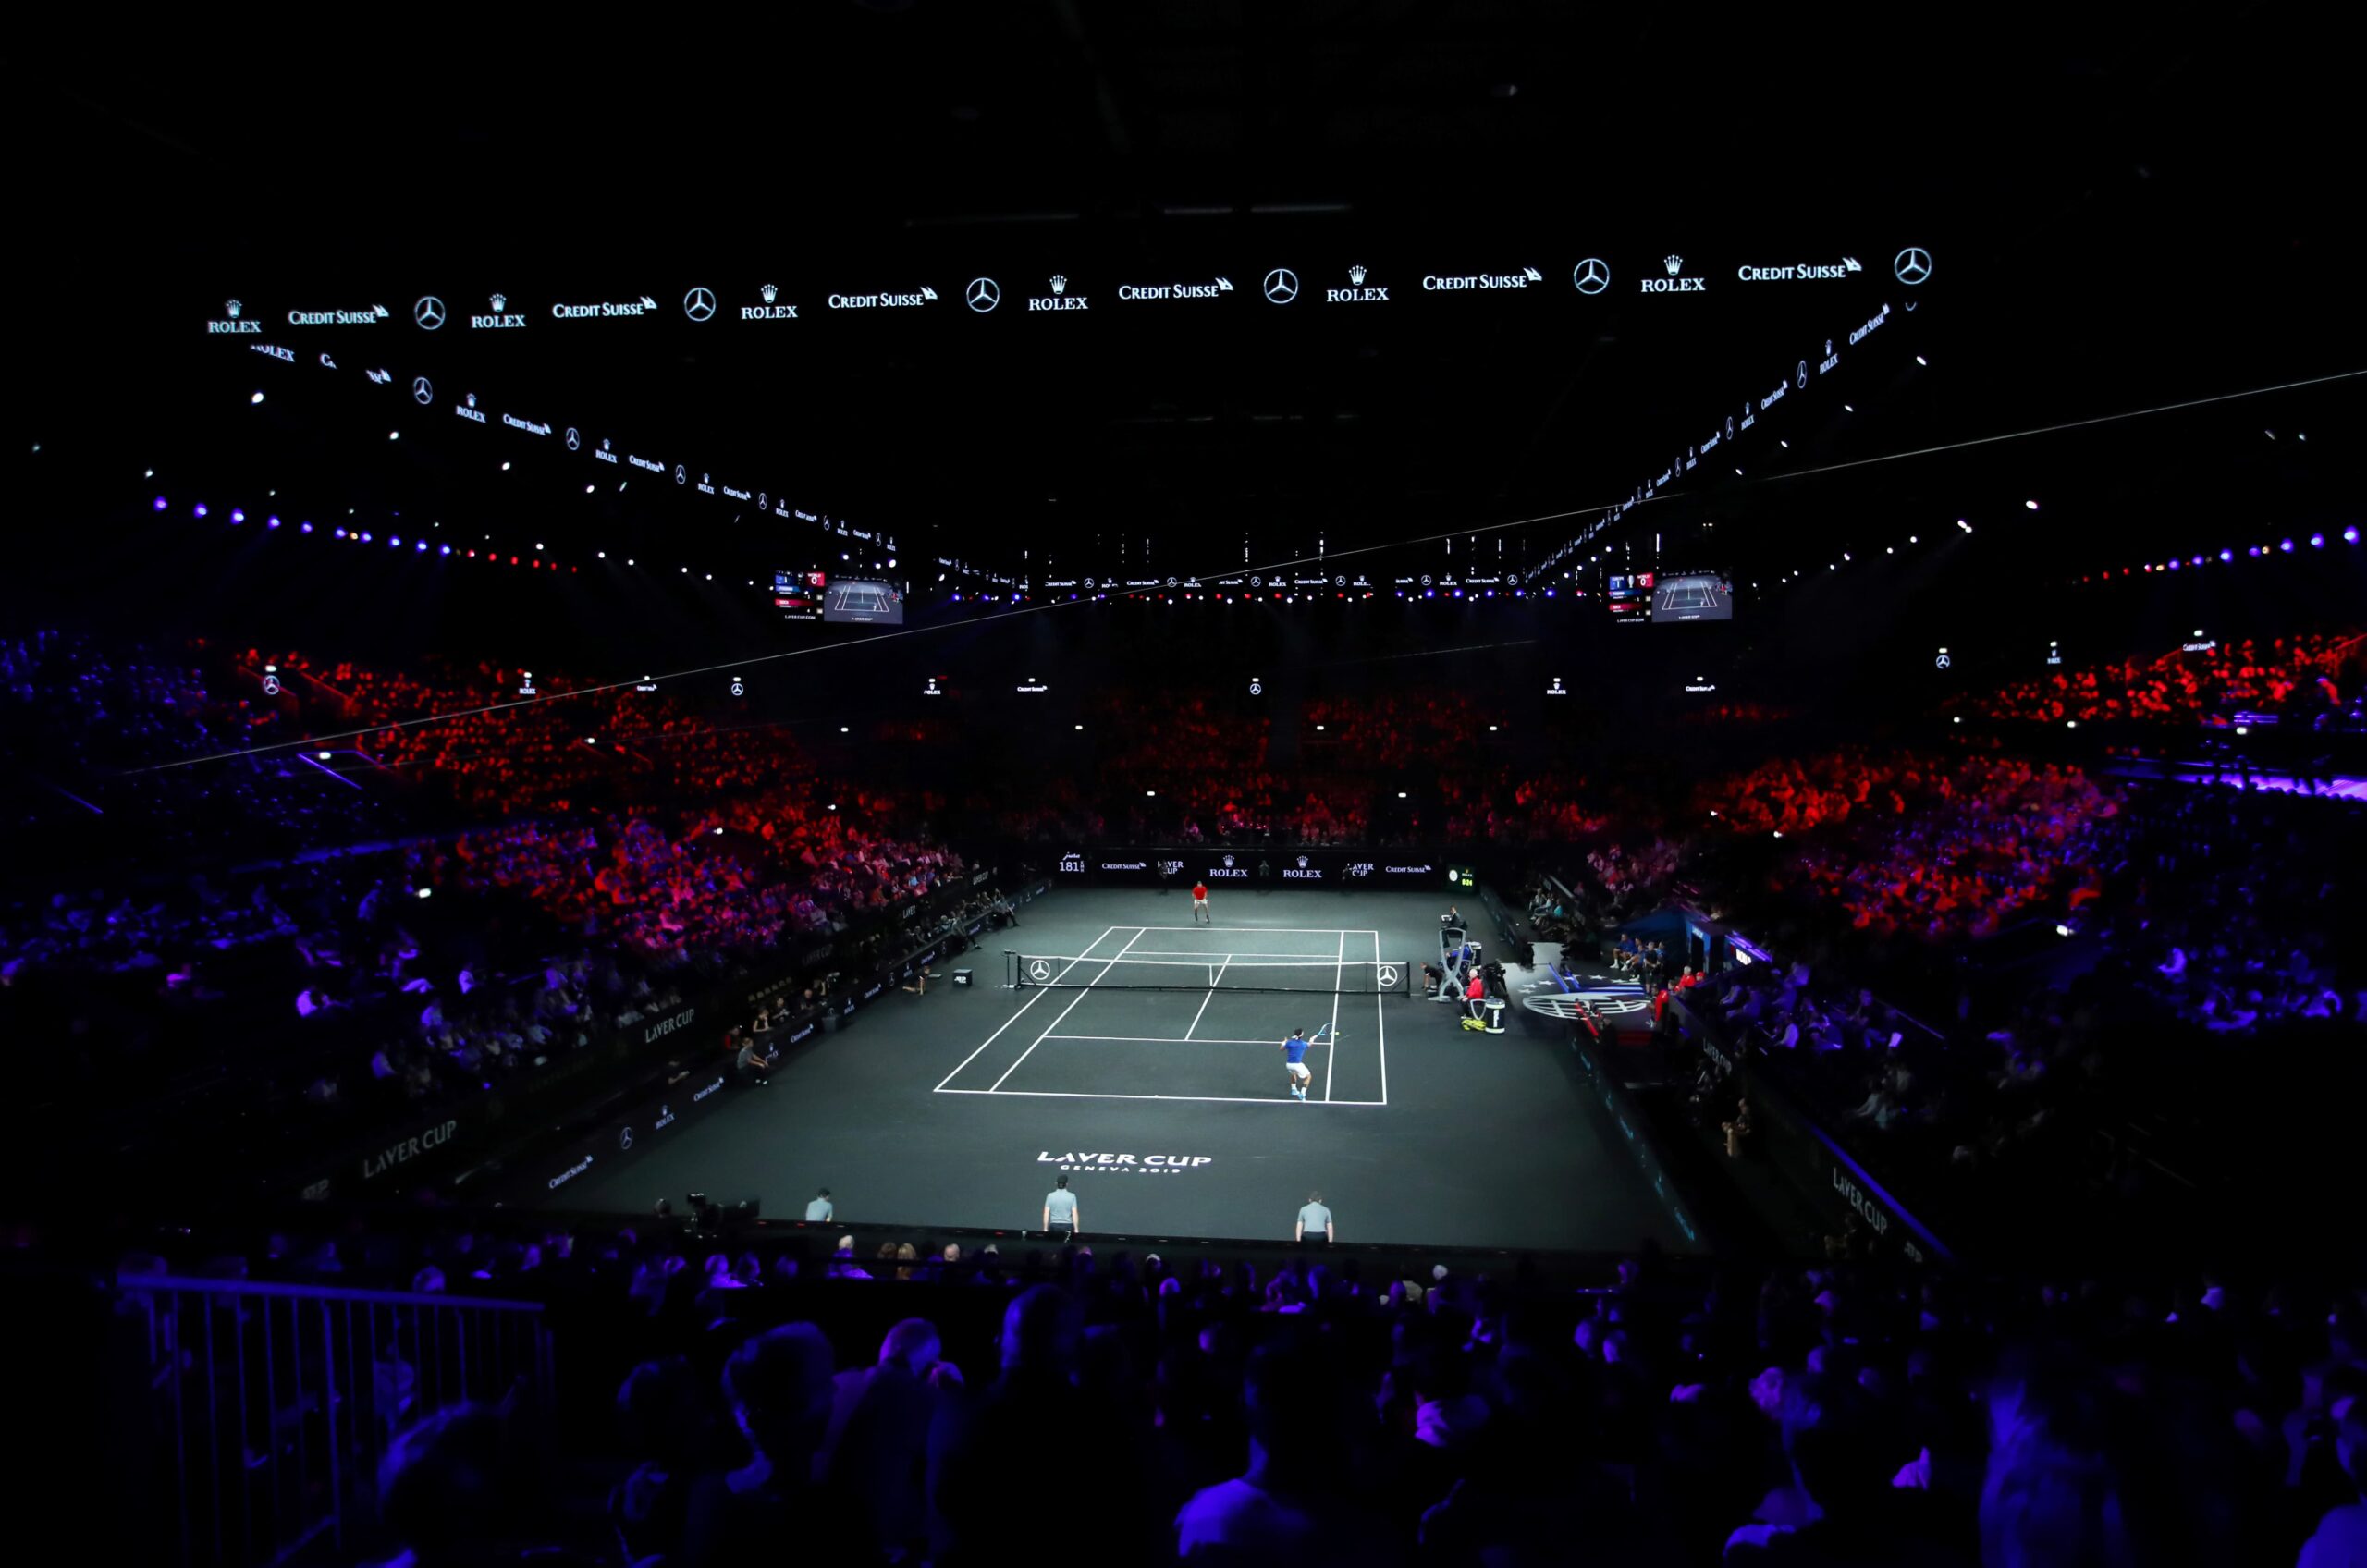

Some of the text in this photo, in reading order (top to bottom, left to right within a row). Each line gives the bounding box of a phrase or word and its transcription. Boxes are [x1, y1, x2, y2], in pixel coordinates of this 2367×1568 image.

[1738, 263, 1846, 280] CREDIT SUISSE
[1423, 274, 1527, 290] CREDIT SUISSE
[1641, 278, 1705, 292] ROLEX
[1119, 283, 1220, 300] CREDIT SUISSE
[1327, 288, 1389, 301] ROLEX
[828, 292, 924, 308] CREDIT SUISSE
[1029, 298, 1088, 311] ROLEX
[288, 309, 376, 325] CREDIT SUISSE
[552, 301, 644, 318] CREDIT SUISSE
[742, 306, 798, 319] ROLEX
[208, 321, 262, 333] ROLEX
[472, 315, 525, 328] ROLEX
[1849, 325, 1867, 345] CREDIT
[1820, 351, 1838, 374] ROLEX
[456, 405, 486, 423] ROLEX
[503, 414, 526, 430] CREDIT
[595, 449, 617, 463] ROLEX
[1640, 578, 1647, 586] 0
[1059, 861, 1079, 872] 181
[1209, 869, 1248, 877] ROLEX
[1282, 870, 1322, 878] ROLEX
[644, 1008, 695, 1045] LAVER CUP
[362, 1120, 457, 1179] LAVER CUP
[1037, 1151, 1212, 1167] LAVER CUP
[1060, 1164, 1130, 1172] GENEVA
[1833, 1166, 1887, 1236] LAVER CUP
